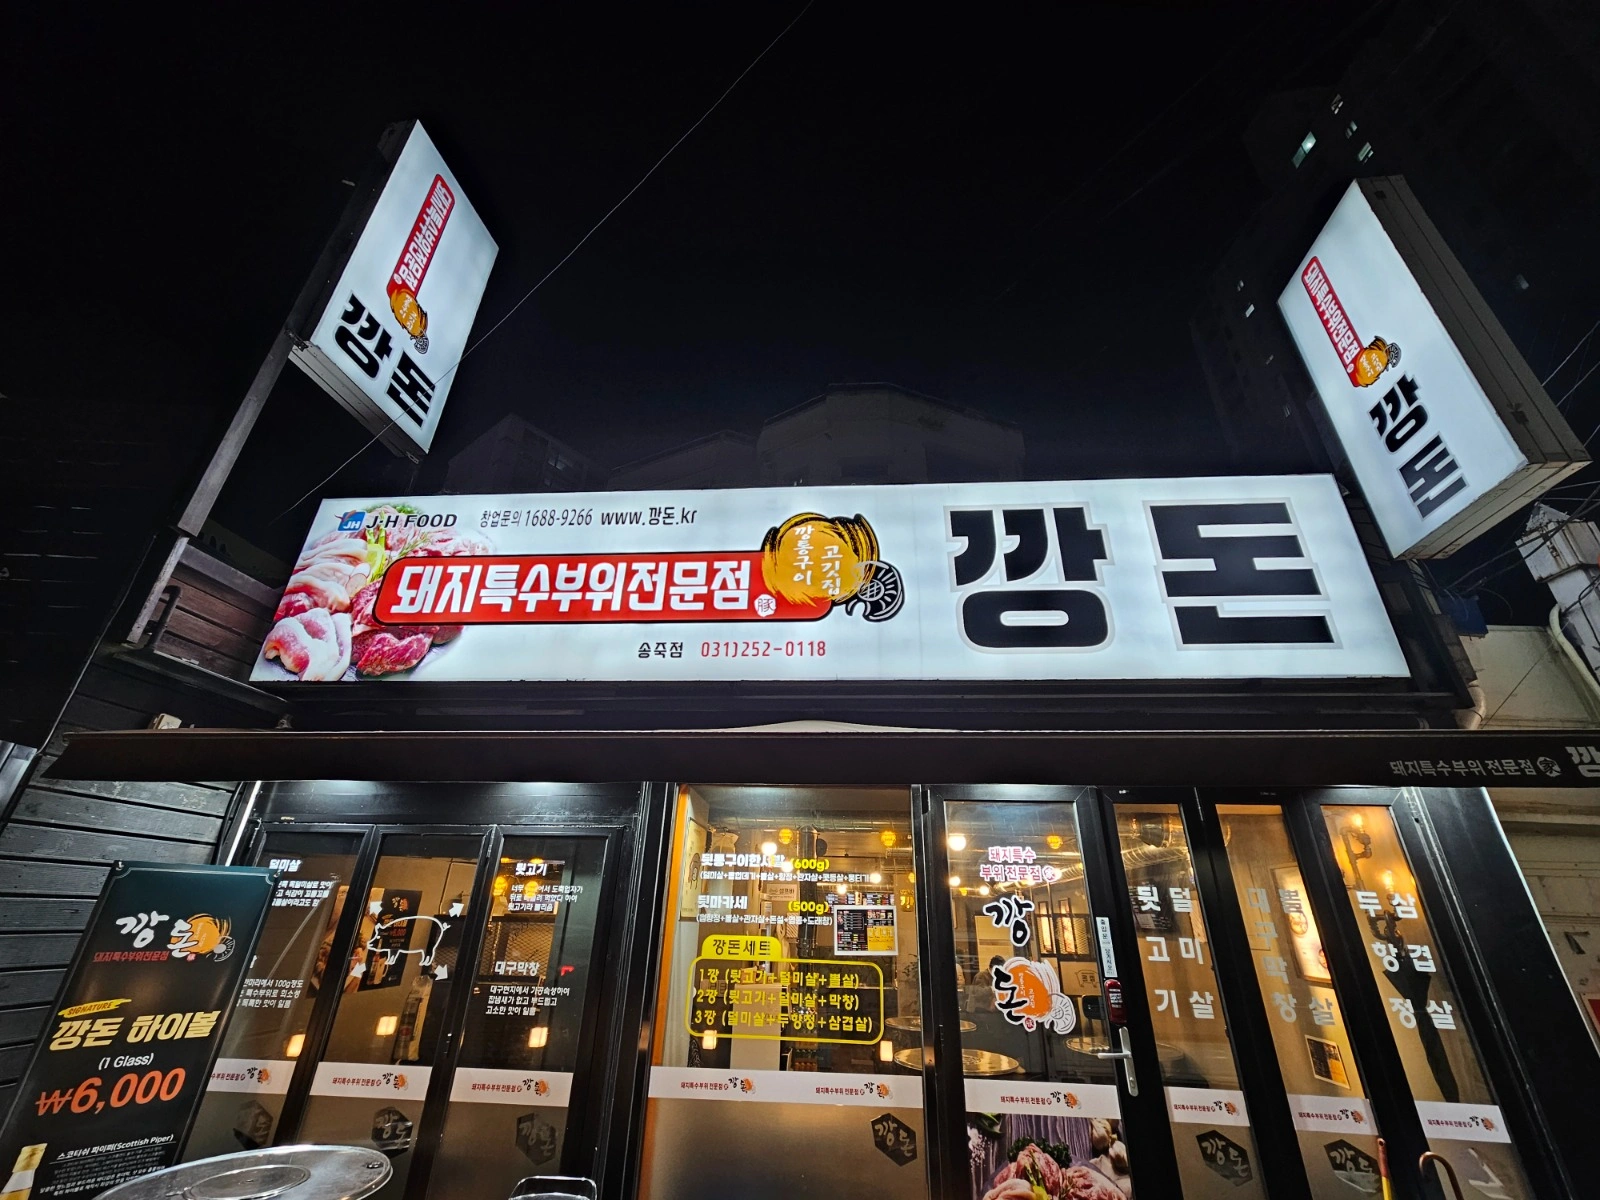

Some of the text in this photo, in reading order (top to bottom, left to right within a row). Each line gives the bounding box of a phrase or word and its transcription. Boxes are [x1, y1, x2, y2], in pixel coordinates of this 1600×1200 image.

[1306, 262, 1360, 366] 돼지특수부위전문점
[404, 514, 457, 527] FOOD
[480, 507, 697, 528] 창업문의 1688-9266 www.깡돈.kr
[391, 560, 750, 613] 돼지특수부위전문점
[638, 640, 826, 659] 송죽점 031)252-0118
[790, 858, 829, 873] (600g)
[989, 847, 1036, 864] 돼지특수
[515, 863, 548, 876] 뒷고기
[980, 865, 1004, 881] 부위
[1006, 865, 1041, 881] 전문점
[788, 901, 829, 915] (500g)
[116, 911, 198, 958] 깡돈
[713, 939, 771, 956] 깡돈세트
[1137, 886, 1179, 1018] 뒷고기
[1169, 887, 1214, 1020] 덜미살
[1247, 887, 1297, 1023] 대구막창
[494, 961, 540, 977] 대구막창
[1355, 891, 1417, 1029] 두항정
[1391, 893, 1457, 1030] 삼겹살
[67, 1001, 114, 1016] SIGNATURE
[485, 1006, 506, 1015] 고소한
[49, 1010, 221, 1050] 깡돈 하이볼
[114, 1053, 154, 1068] Glass)
[35, 1068, 186, 1116] ₩6,000
[874, 1121, 915, 1157] 깡돈
